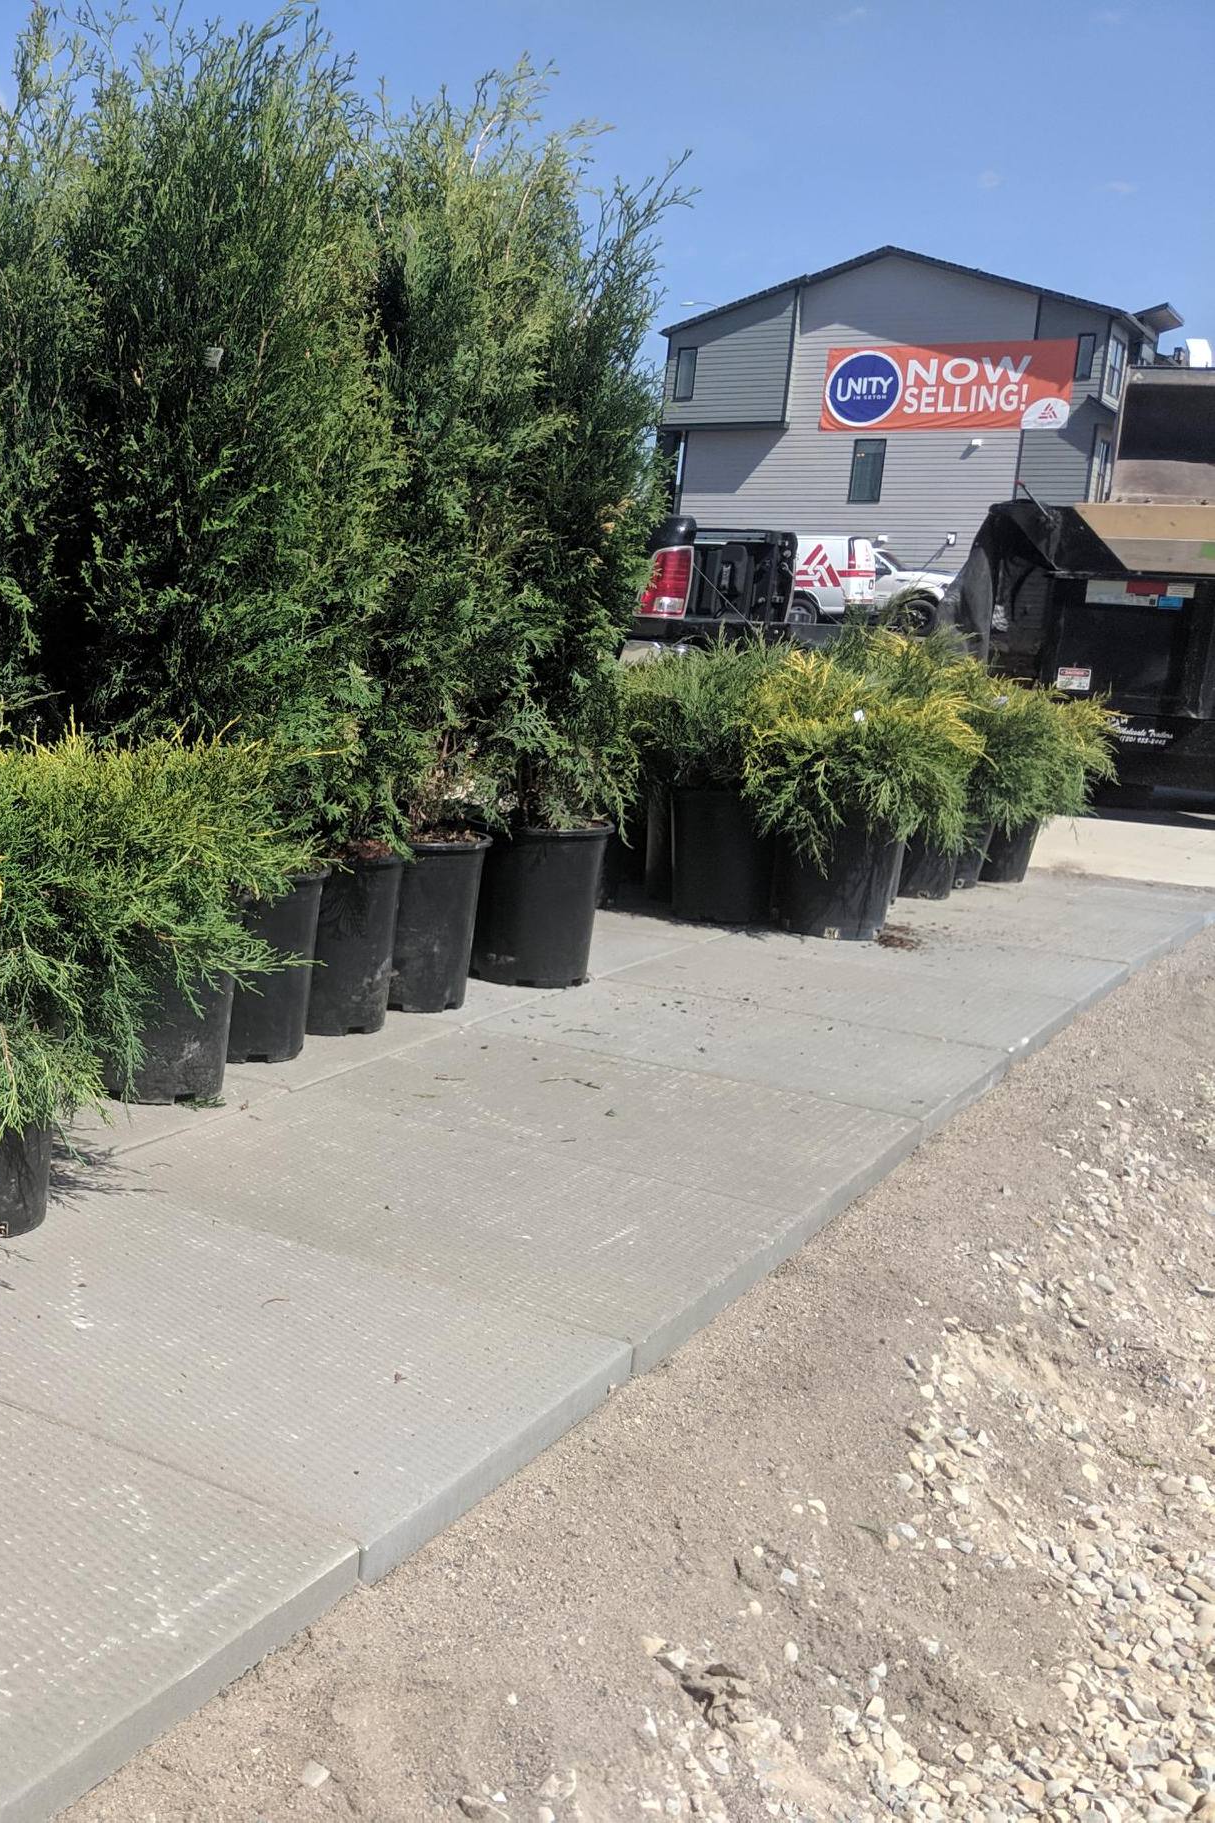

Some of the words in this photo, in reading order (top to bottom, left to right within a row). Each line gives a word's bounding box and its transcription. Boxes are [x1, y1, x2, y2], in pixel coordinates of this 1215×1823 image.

[906, 355, 1032, 386] NOW
[836, 376, 894, 402] UNITY
[902, 383, 1029, 414] SELLING!
